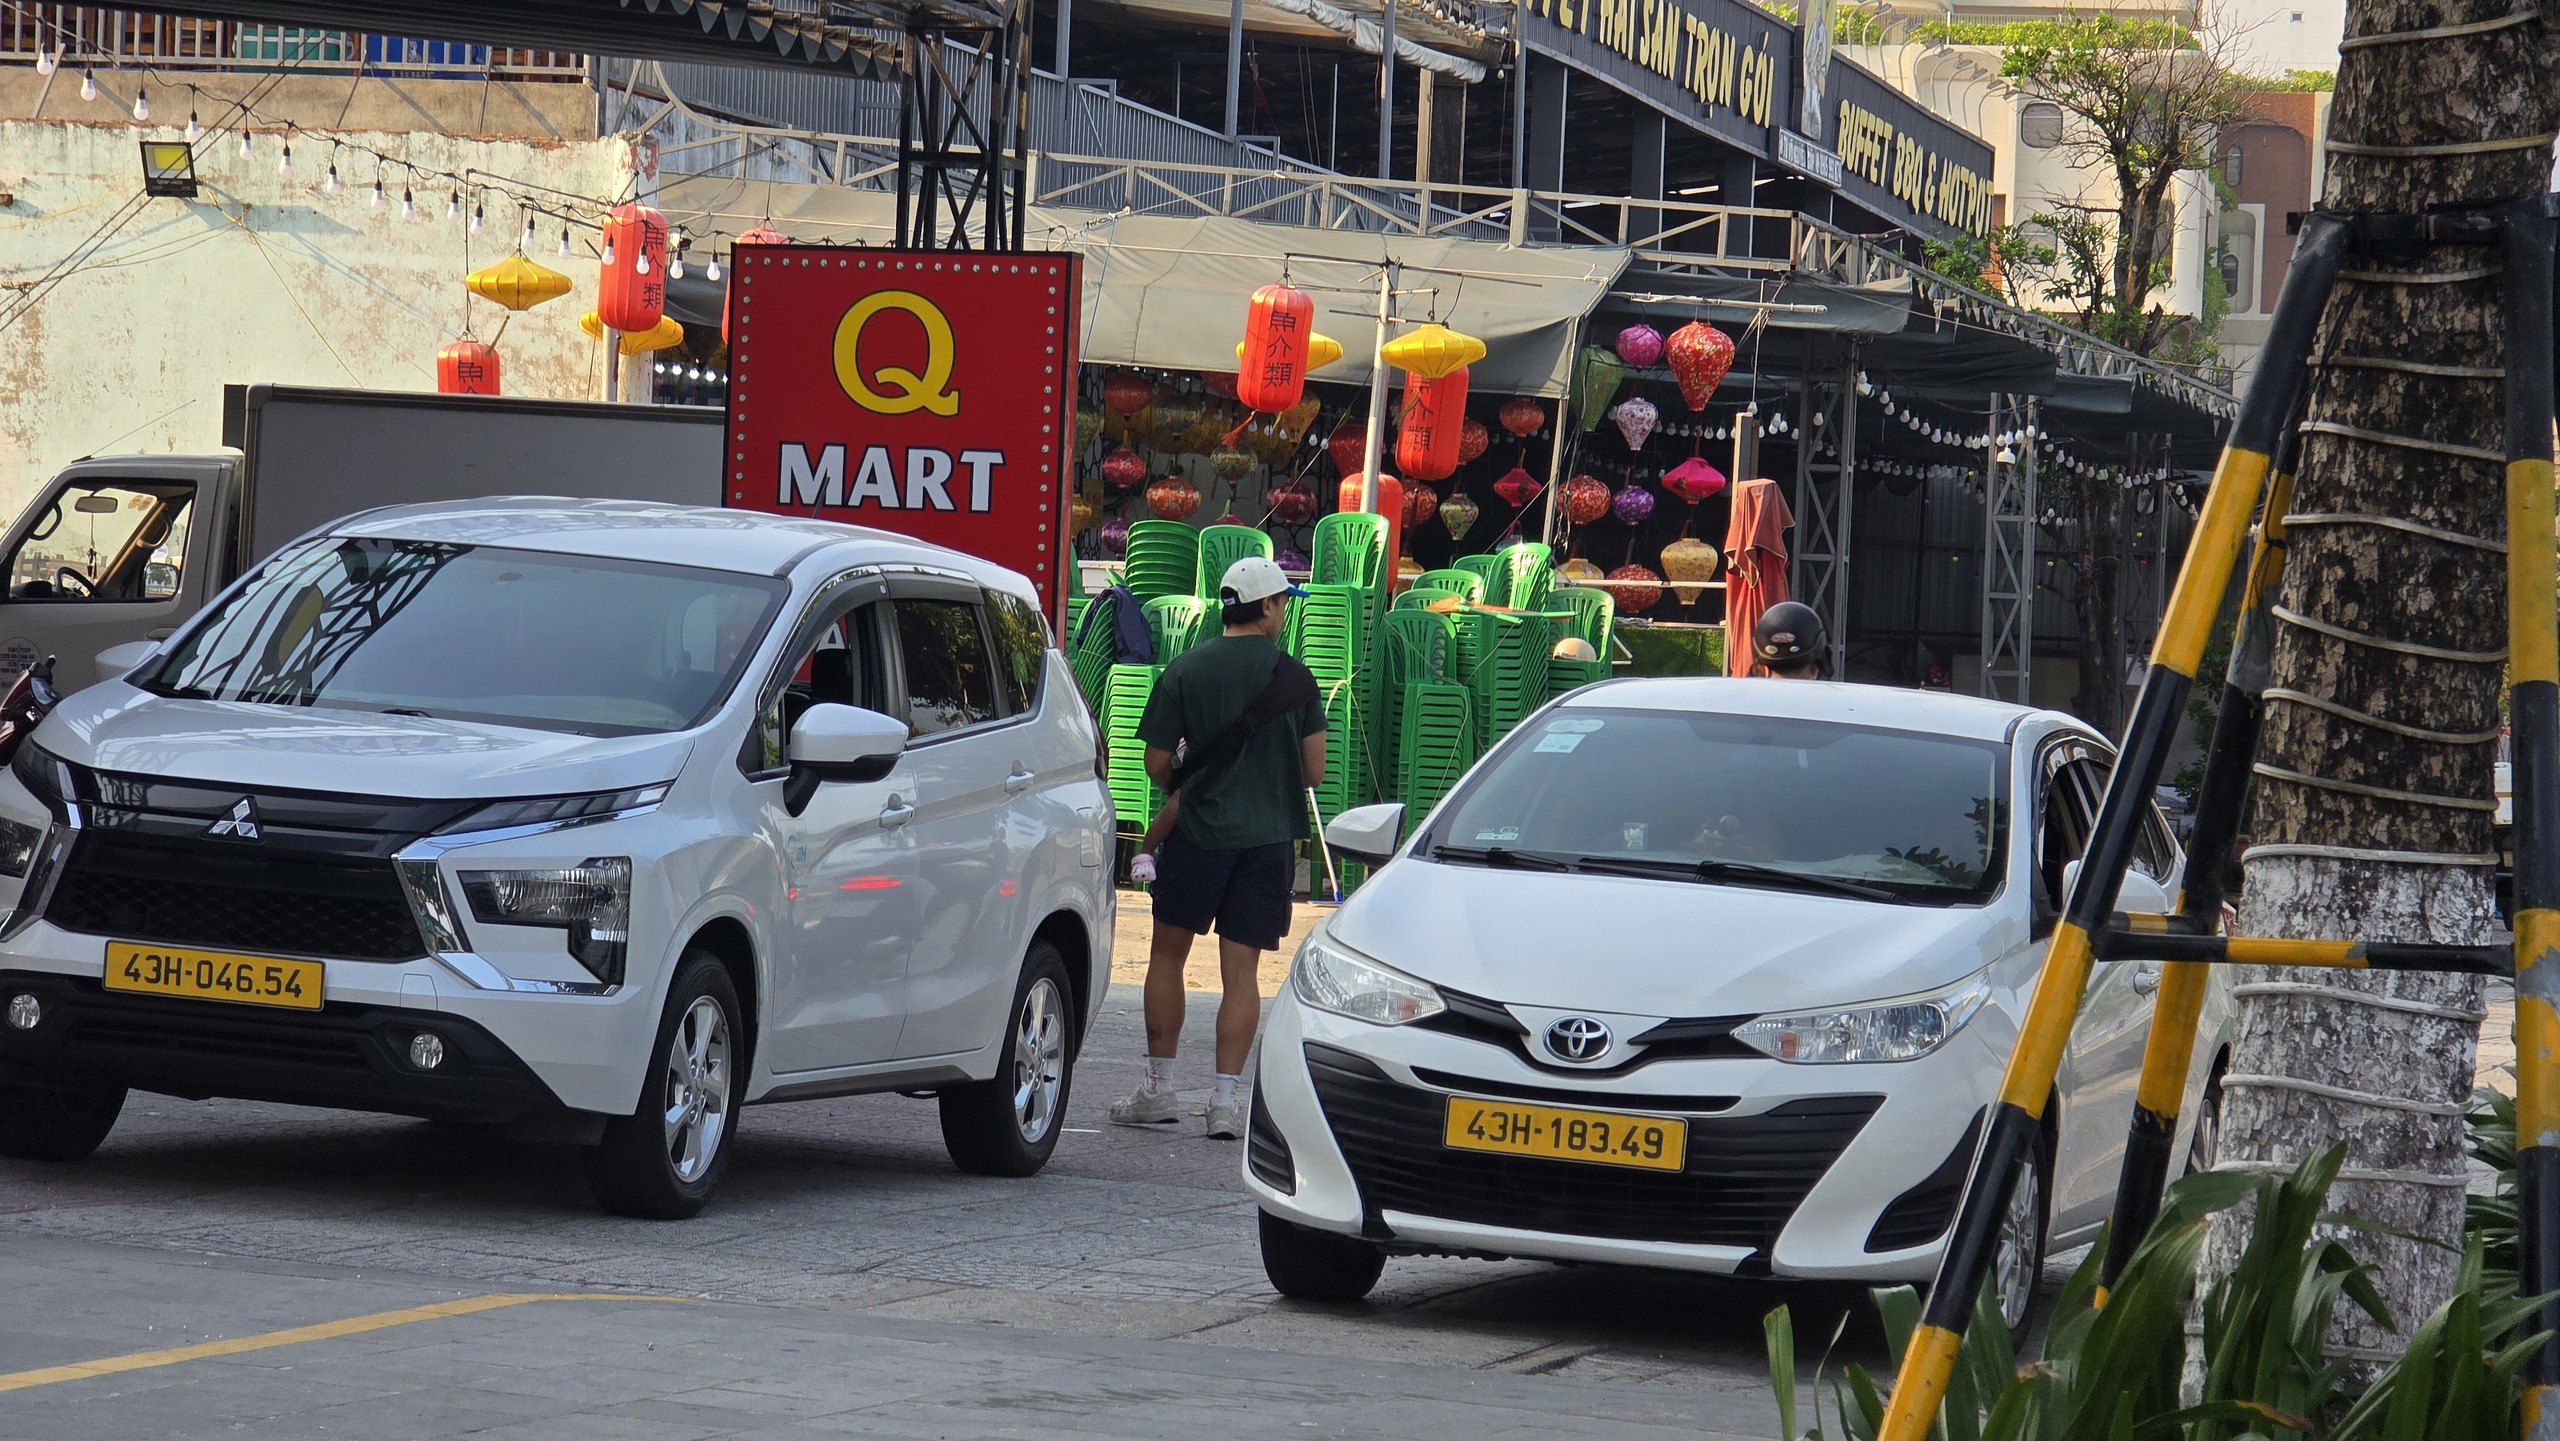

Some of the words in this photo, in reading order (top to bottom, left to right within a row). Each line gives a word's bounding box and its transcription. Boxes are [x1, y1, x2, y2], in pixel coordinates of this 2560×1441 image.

[1686, 12, 1736, 119] TRỌN
[1739, 31, 1775, 129] GÓI
[1837, 99, 1893, 188] BUFFET
[1893, 132, 1923, 216] BBQ
[1937, 157, 1994, 239] HOTPOT
[832, 289, 961, 418] Q
[1264, 309, 1296, 389] 魚介類
[778, 441, 1005, 513] MART
[124, 953, 302, 998] 43H-046.54
[1467, 1110, 1664, 1159] 43H-183.49
